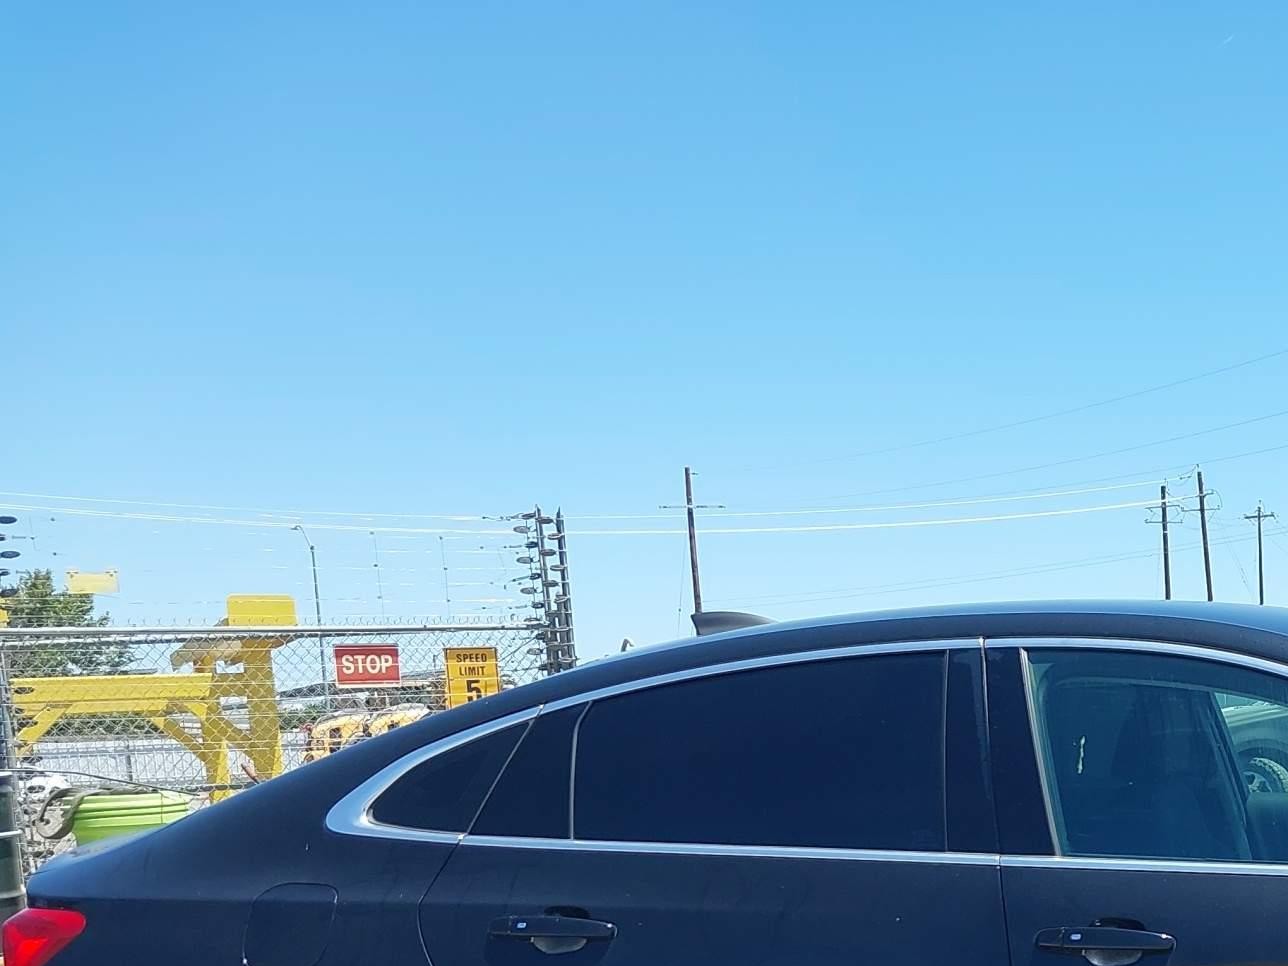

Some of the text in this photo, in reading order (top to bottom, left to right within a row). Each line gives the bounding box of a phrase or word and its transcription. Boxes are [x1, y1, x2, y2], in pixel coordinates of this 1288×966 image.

[342, 655, 393, 674] STOP
[455, 653, 488, 663] SPEED
[458, 666, 486, 676] LIMIT
[466, 679, 482, 702] 5
